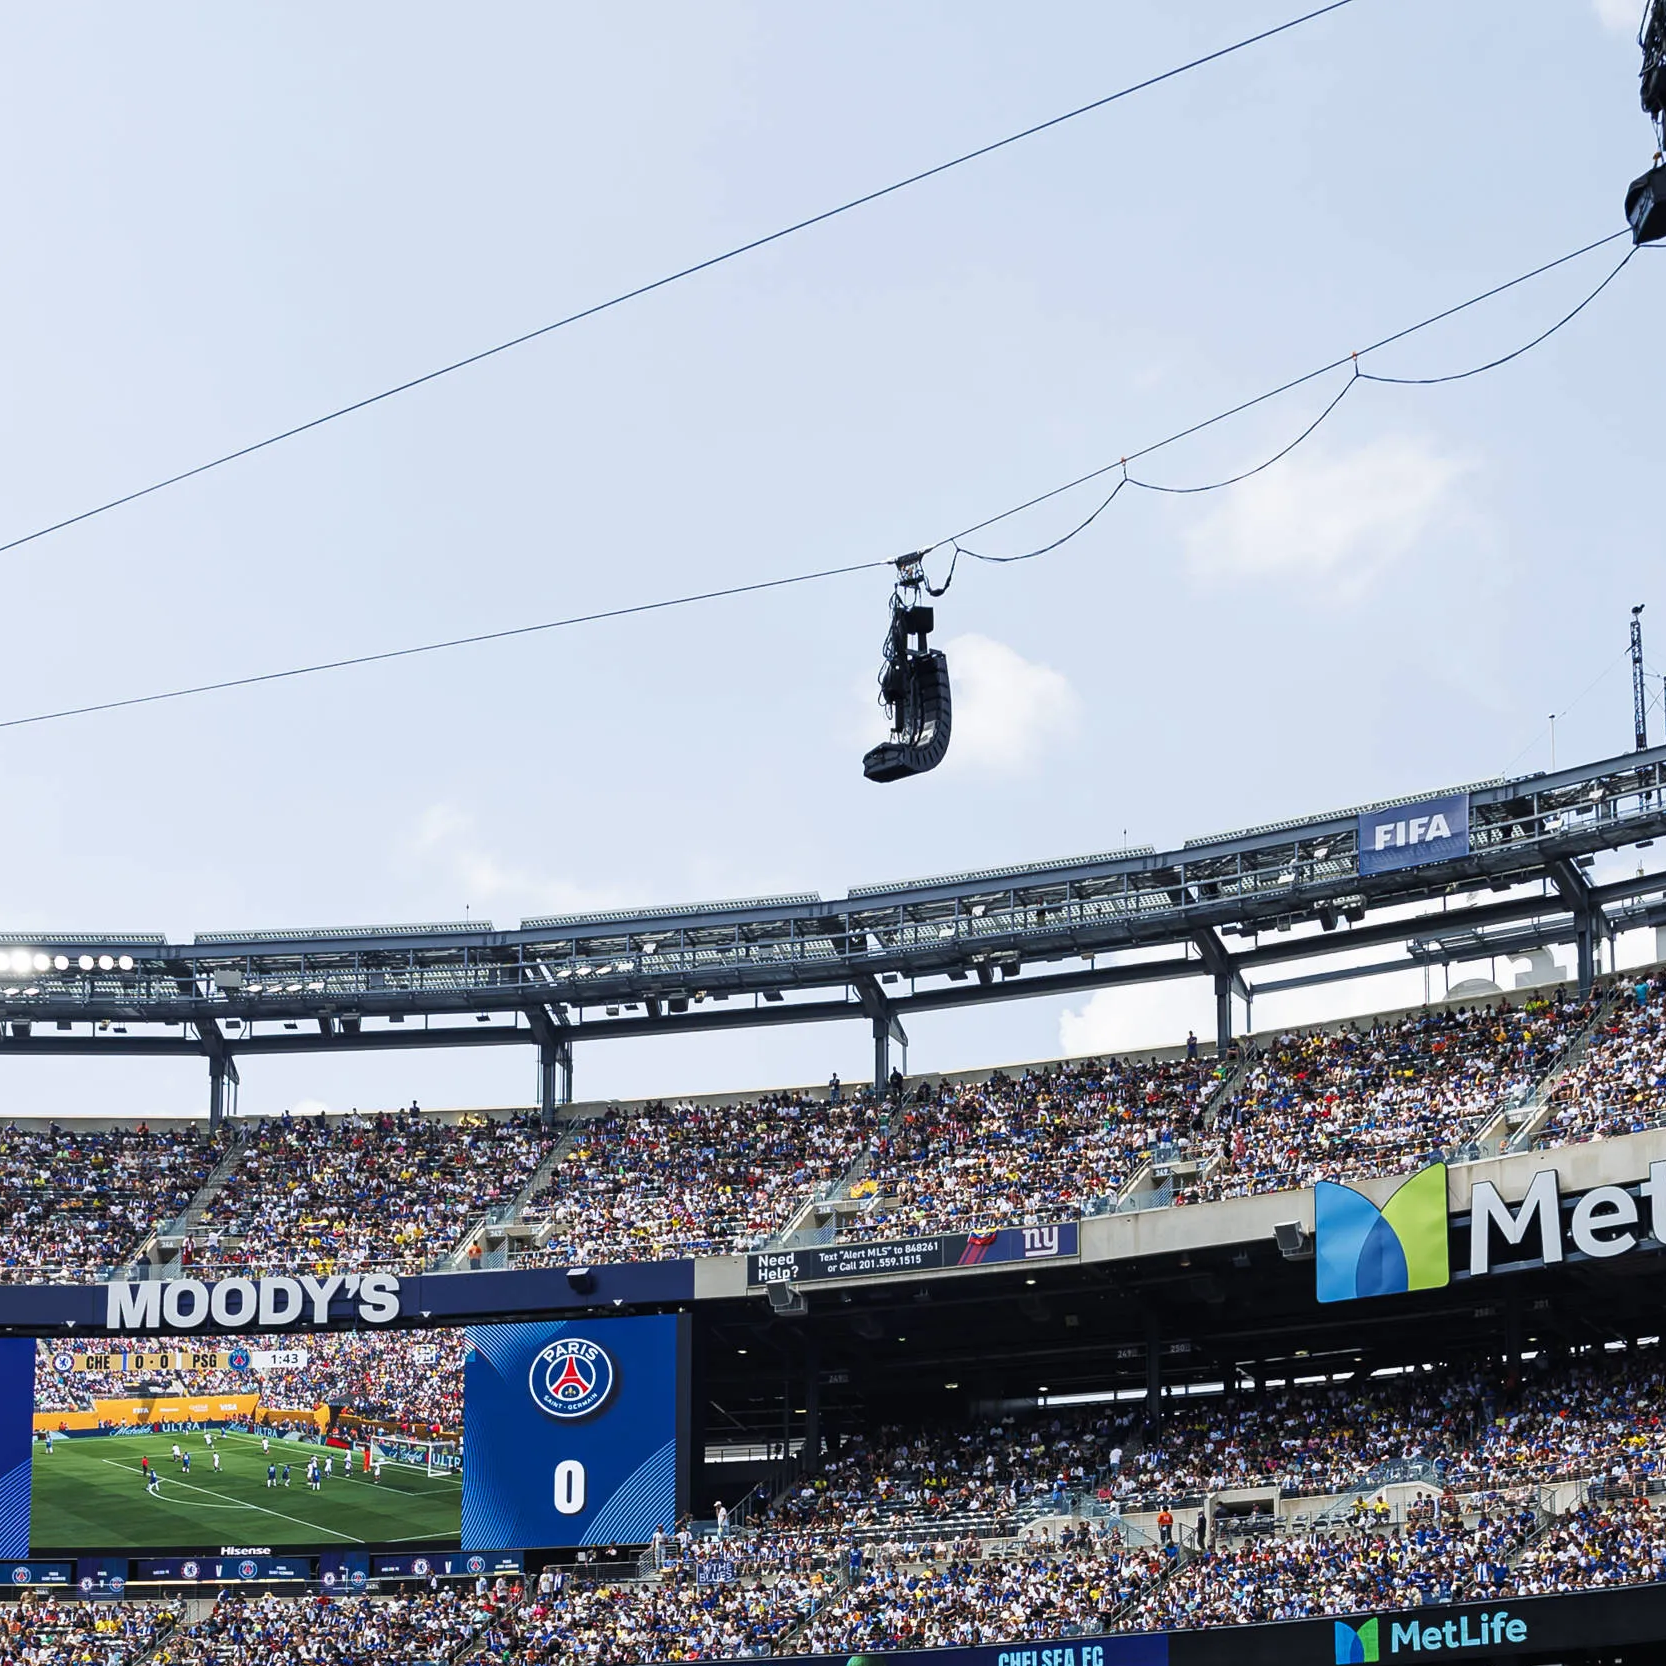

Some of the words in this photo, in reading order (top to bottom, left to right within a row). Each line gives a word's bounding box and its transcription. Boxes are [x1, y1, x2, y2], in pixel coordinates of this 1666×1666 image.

[1375, 814, 1451, 851] FIFA
[758, 1253, 795, 1267] Need
[819, 1253, 838, 1262] Text
[894, 1246, 903, 1254] to
[905, 1241, 939, 1253] 848261
[827, 1264, 837, 1273] or
[839, 1260, 857, 1272] Call
[859, 1255, 921, 1270] 201.559.1515
[758, 1266, 799, 1282] Help?
[106, 1273, 400, 1329] MOODY'S
[86, 1355, 110, 1370] CHE
[135, 1354, 144, 1370] 0
[160, 1353, 169, 1369] 0
[193, 1353, 217, 1369] PSG
[270, 1354, 299, 1366] 1:43
[542, 1342, 599, 1364] PARIS
[162, 1421, 200, 1433] ULTRA
[254, 1426, 278, 1439] ULTRA
[554, 1459, 585, 1515] 0
[220, 1546, 271, 1556] Hisense
[215, 1564, 223, 1577] V
[444, 1560, 451, 1574] V
[1391, 1611, 1528, 1653] MetLife
